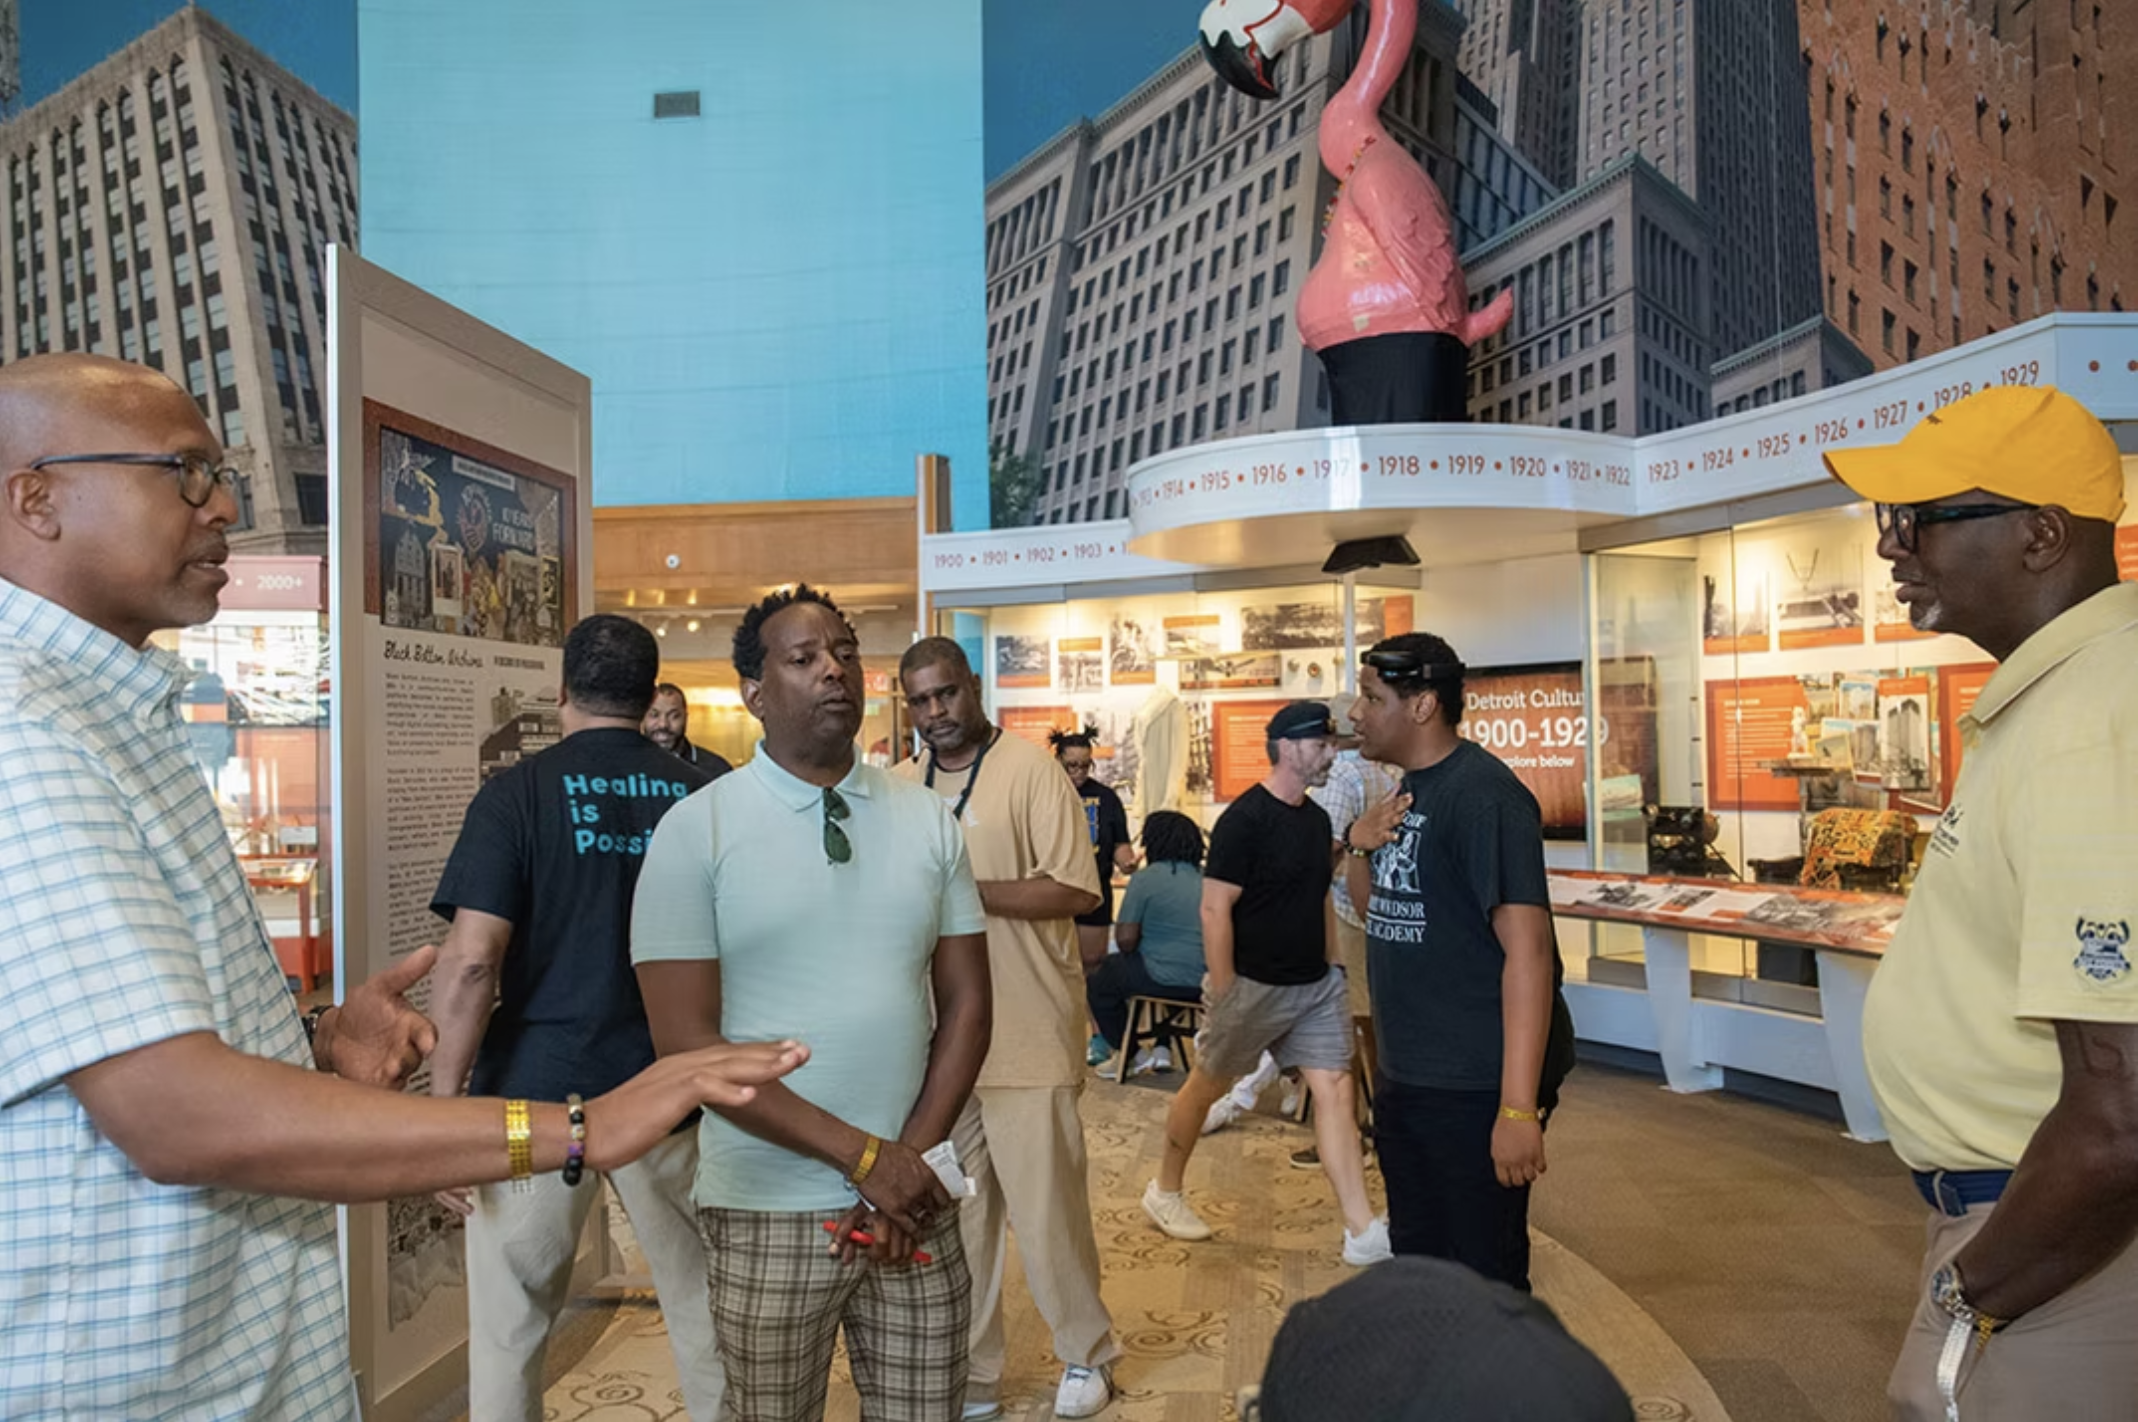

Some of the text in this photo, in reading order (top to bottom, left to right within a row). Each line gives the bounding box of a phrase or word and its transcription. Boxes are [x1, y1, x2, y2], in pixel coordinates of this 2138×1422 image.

[1648, 360, 2039, 483] 1923 1924 1925 1926 1927 1928 1929
[1201, 469, 1231, 492] 1915
[1252, 463, 1287, 486] 1916
[1313, 457, 1350, 479] 1917
[1378, 455, 1420, 477] 1918
[1448, 455, 1486, 476] 1919
[1510, 456, 1547, 477] 1920
[1565, 460, 1591, 481] 1921
[1605, 464, 1631, 487] 1922
[934, 543, 1102, 568] 1900 1901 1902 1903
[1466, 690, 1526, 710] Detroit
[1538, 754, 1576, 768] below
[562, 772, 688, 801] Healing
[568, 799, 600, 824] is
[574, 829, 654, 855] Possi
